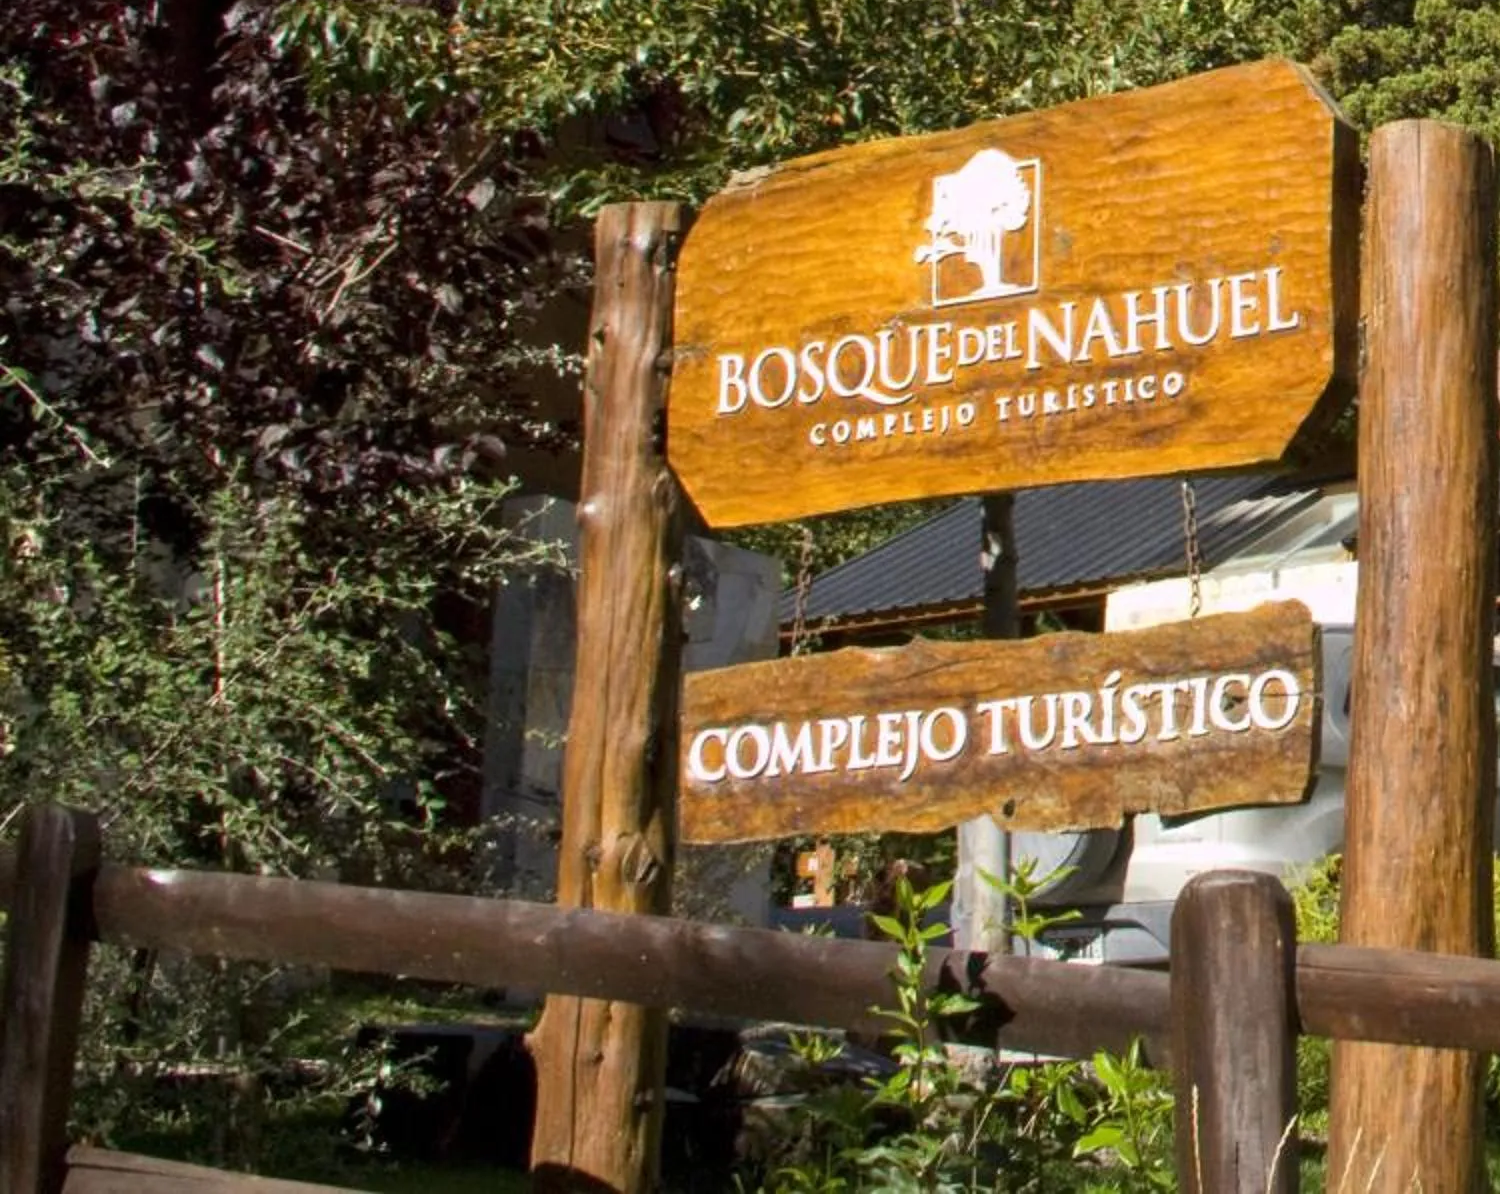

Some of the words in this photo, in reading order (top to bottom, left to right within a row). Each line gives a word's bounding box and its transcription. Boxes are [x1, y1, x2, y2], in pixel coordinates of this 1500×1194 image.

[717, 320, 954, 415] BOSQUE
[957, 321, 1021, 367] DEL
[1026, 267, 1299, 370] NAHUEL
[809, 401, 976, 447] COMPLEJO
[688, 707, 967, 781] COMPLEJO
[977, 671, 1299, 755] TURÍSTICO
